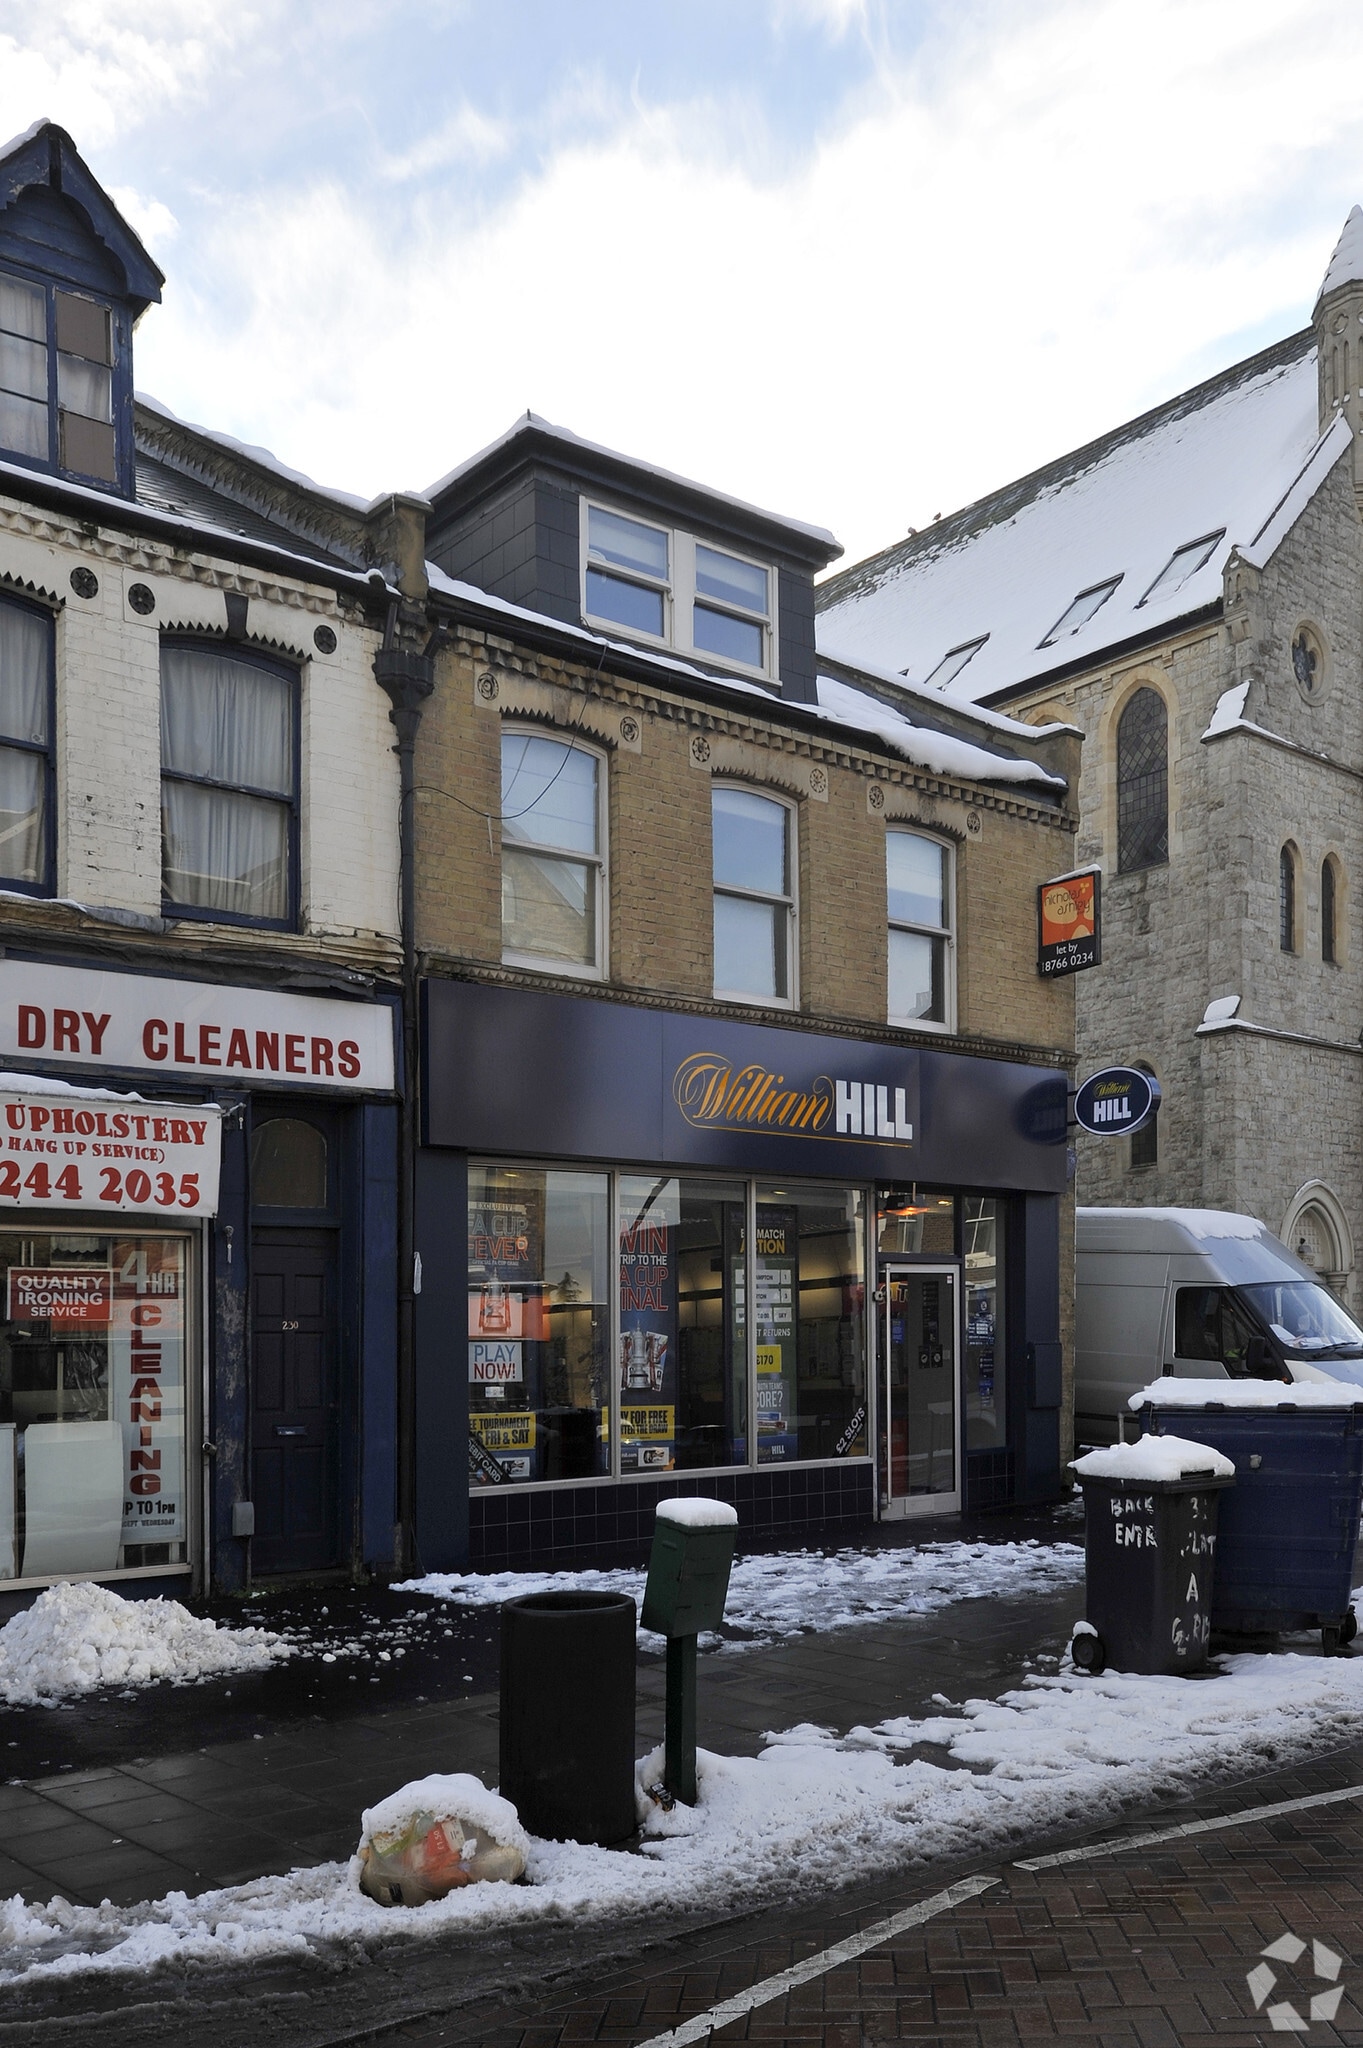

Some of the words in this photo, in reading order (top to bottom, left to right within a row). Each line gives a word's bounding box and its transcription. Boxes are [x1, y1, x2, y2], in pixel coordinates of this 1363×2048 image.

[1044, 889, 1081, 907] nicholas
[1057, 900, 1090, 915] ashley
[1056, 945, 1067, 955] let
[1068, 942, 1078, 954] by
[1045, 958, 1068, 972] 8766
[1070, 951, 1094, 966] 0234
[17, 1004, 112, 1055] DRY
[142, 1018, 361, 1078] CLEANERS
[673, 1052, 835, 1132] William
[835, 1079, 913, 1140] HILL
[1093, 1079, 1132, 1099] William
[1093, 1096, 1132, 1123] HILL
[5, 1104, 208, 1145] UPHOLSTERY
[8, 1136, 58, 1154] HANG
[63, 1141, 87, 1156] UP
[92, 1143, 166, 1164] SERVICE)
[0, 1160, 83, 1200] 244
[99, 1166, 201, 1209] 2035
[491, 1214, 529, 1237] CUP
[756, 1228, 785, 1240] MATCH
[620, 1219, 668, 1254] WIN
[637, 1254, 649, 1265] TO
[650, 1255, 668, 1266] THE
[119, 1250, 149, 1294] 4
[152, 1272, 175, 1294] HR
[635, 1265, 669, 1287] CUP
[17, 1275, 104, 1291] QUALITY
[18, 1291, 103, 1306] IRONING
[620, 1286, 669, 1312] INAL
[30, 1306, 87, 1317] SERVICE
[282, 1320, 299, 1330] 230
[763, 1328, 791, 1338] RETURNS
[474, 1344, 516, 1363] PLAY
[474, 1362, 516, 1380] NOW!
[129, 1304, 164, 1496] CLEANING
[756, 1391, 783, 1409] CORE?
[478, 1416, 531, 1430] TOURNAMENT
[630, 1410, 647, 1424] FOR
[648, 1410, 669, 1424] FREE
[485, 1429, 500, 1446] FRI
[502, 1431, 511, 1445] &
[511, 1429, 531, 1444] SAT
[636, 1424, 648, 1435] THE
[835, 1437, 848, 1455] £2
[844, 1407, 865, 1440] SLOTS
[771, 1445, 785, 1456] HILL
[481, 1459, 501, 1483] CARD
[122, 1501, 134, 1516] P
[136, 1500, 153, 1515] TO
[155, 1500, 176, 1514] 1PM
[141, 1518, 175, 1527] WEDNESDAY
[1185, 1572, 1199, 1603] A
